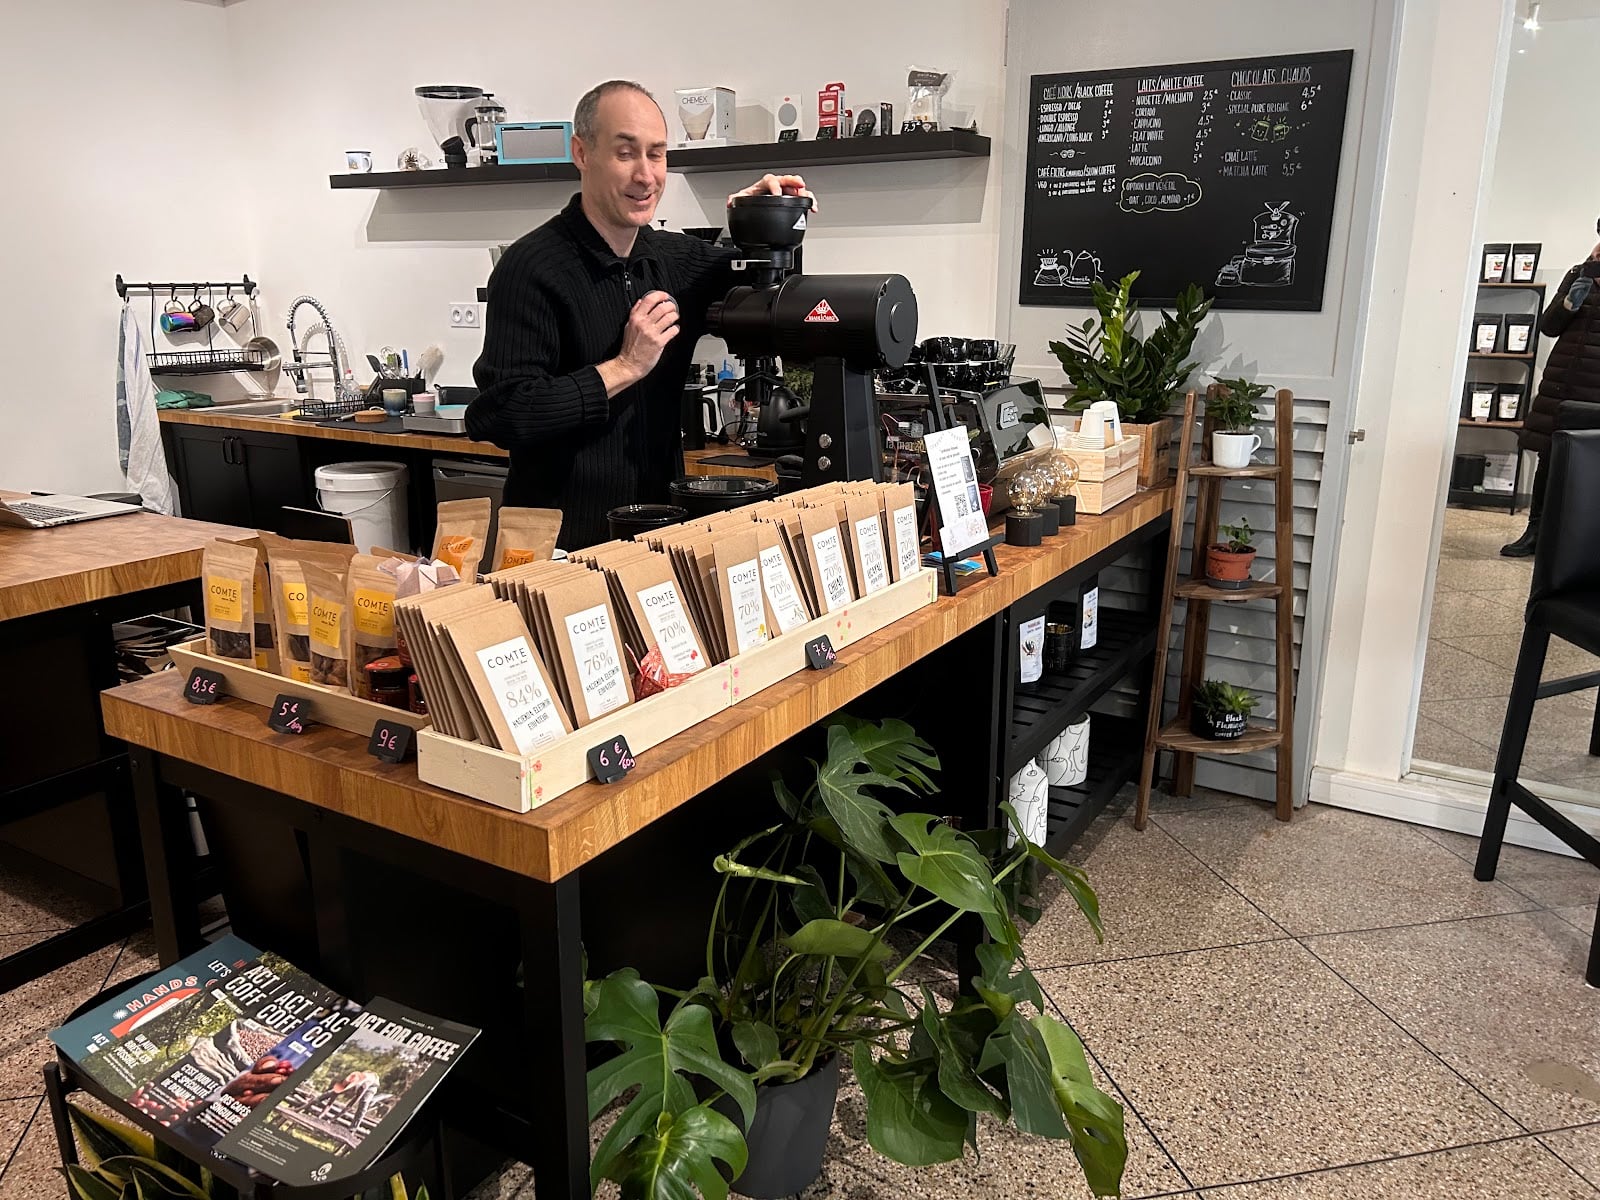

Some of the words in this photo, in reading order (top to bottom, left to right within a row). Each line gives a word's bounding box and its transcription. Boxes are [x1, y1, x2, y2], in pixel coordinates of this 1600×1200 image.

[1183, 75, 1204, 88] COFFEE
[1231, 69, 1276, 87] CHOCOLATS
[1281, 66, 1312, 84] CHAUDS
[1095, 84, 1114, 97] COFFEE
[1230, 91, 1251, 101] CLASSIC
[682, 95, 708, 104] CHEMEX
[1250, 103, 1266, 113] PURE
[1131, 142, 1148, 153] LATTE
[1240, 150, 1258, 161] LATTE
[1037, 165, 1050, 177] CAFÉ
[1250, 164, 1269, 176] LATTE
[860, 523, 878, 536] COMTE
[817, 535, 836, 550] COMTE
[732, 568, 757, 584] COMTE
[211, 585, 237, 599] COMTE
[769, 580, 791, 598] 70%
[357, 598, 389, 612] COMTE
[645, 590, 674, 607] COMTE
[313, 606, 337, 621] COMTE
[738, 600, 760, 620] 70%
[572, 615, 606, 635] COMTE
[660, 619, 686, 643] 70%
[487, 647, 527, 669] COMTE
[584, 650, 613, 676] 76%
[191, 676, 217, 694] 8,5€
[505, 681, 542, 708] 84%
[377, 729, 398, 750] 9€
[207, 959, 232, 978] LET'S
[243, 965, 281, 989] ACT
[125, 975, 199, 1013] HANDS
[274, 990, 314, 1015] ACT
[91, 1033, 110, 1046] ACT
[349, 1011, 387, 1032] ACT
[380, 1022, 412, 1044] FOR
[405, 1032, 460, 1062] COFFEE
[219, 1093, 235, 1106] DES
